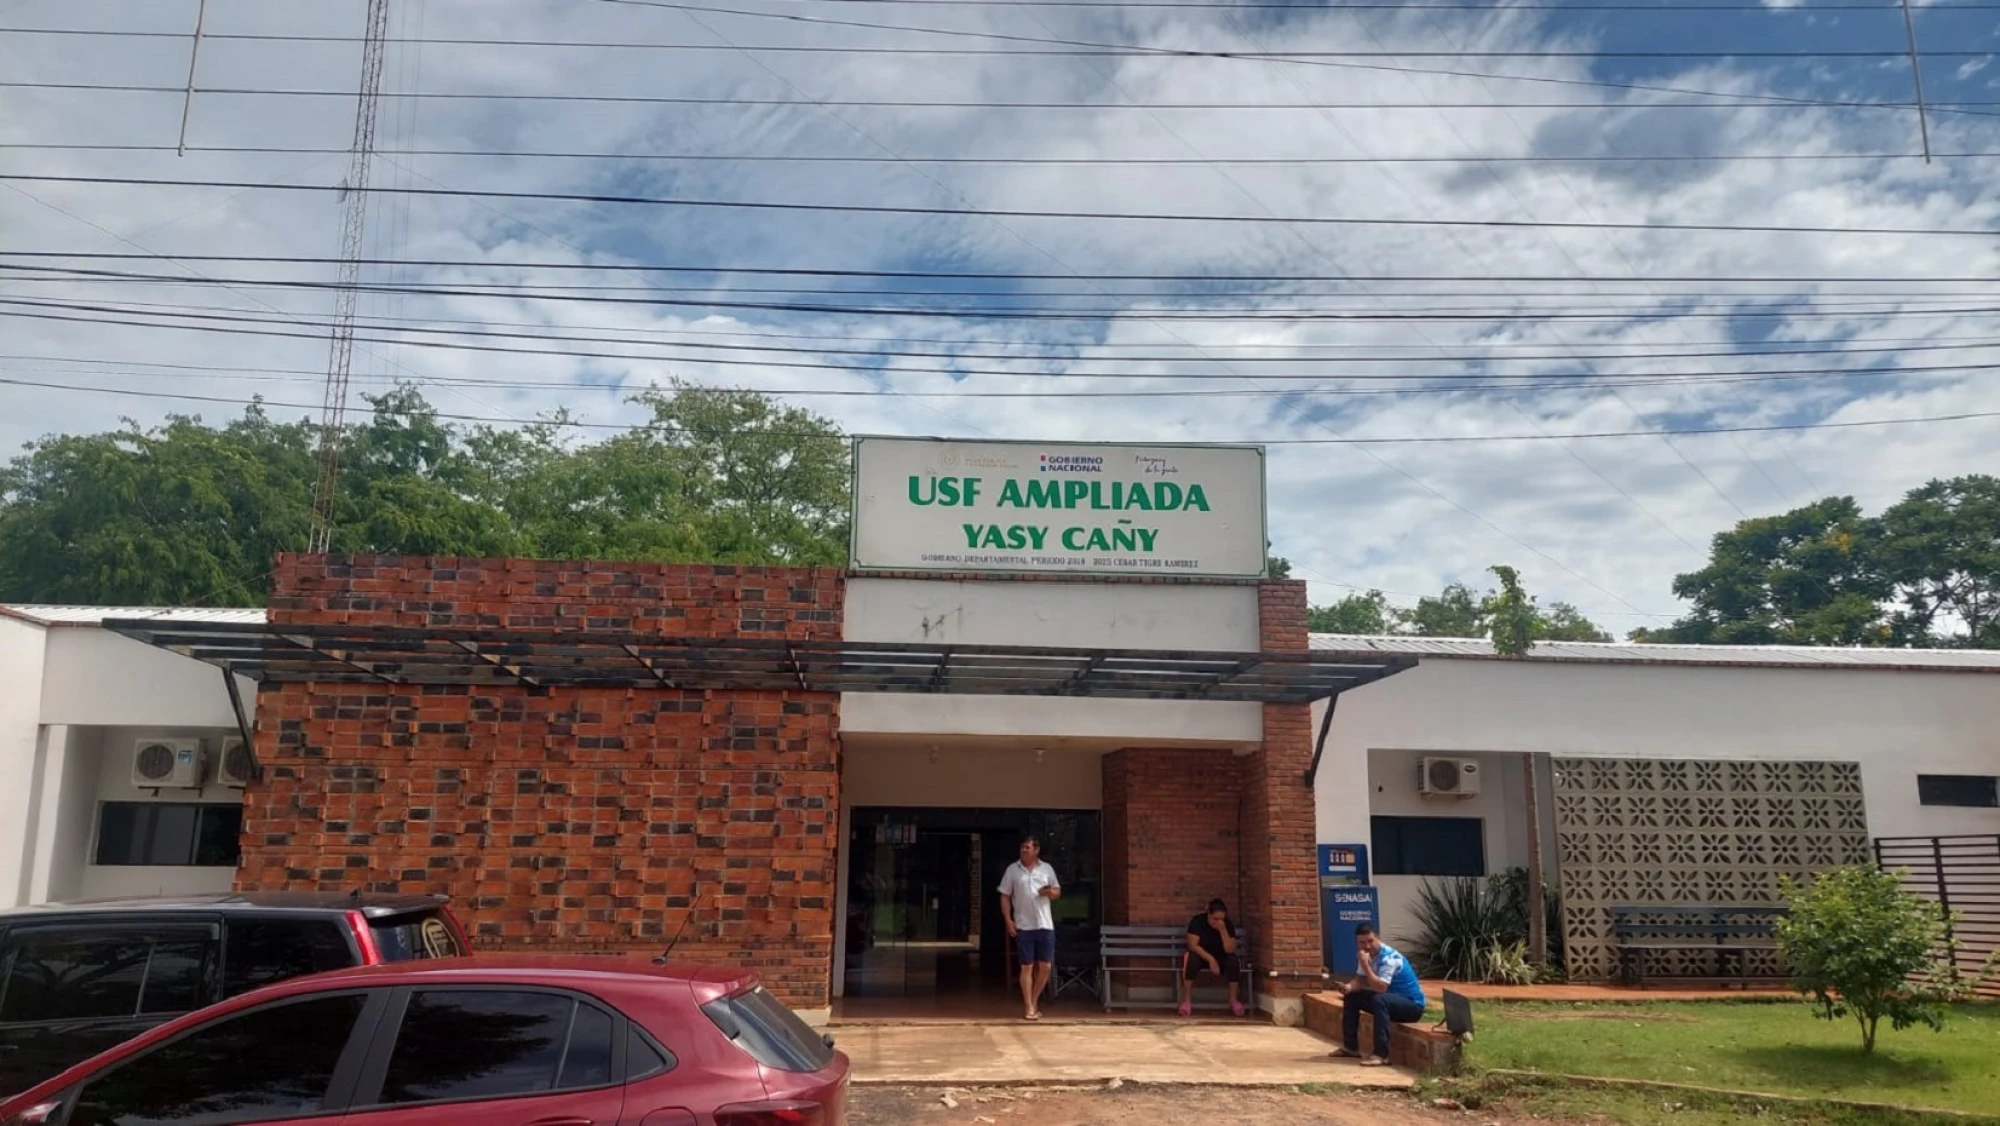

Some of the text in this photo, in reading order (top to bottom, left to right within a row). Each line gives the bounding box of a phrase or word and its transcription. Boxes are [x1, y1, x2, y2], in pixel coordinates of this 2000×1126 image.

[1048, 456, 1104, 465] GOBIERNO
[1048, 464, 1103, 473] NACIONAL
[908, 476, 1210, 512] USF AMPLIADA
[962, 519, 1159, 552] YASY CAÑY
[921, 554, 961, 562] GOBIERNO
[964, 555, 1027, 564] DEPARTAMENTAL
[1031, 556, 1065, 565] PERIODO
[1334, 893, 1372, 903] SENASA
